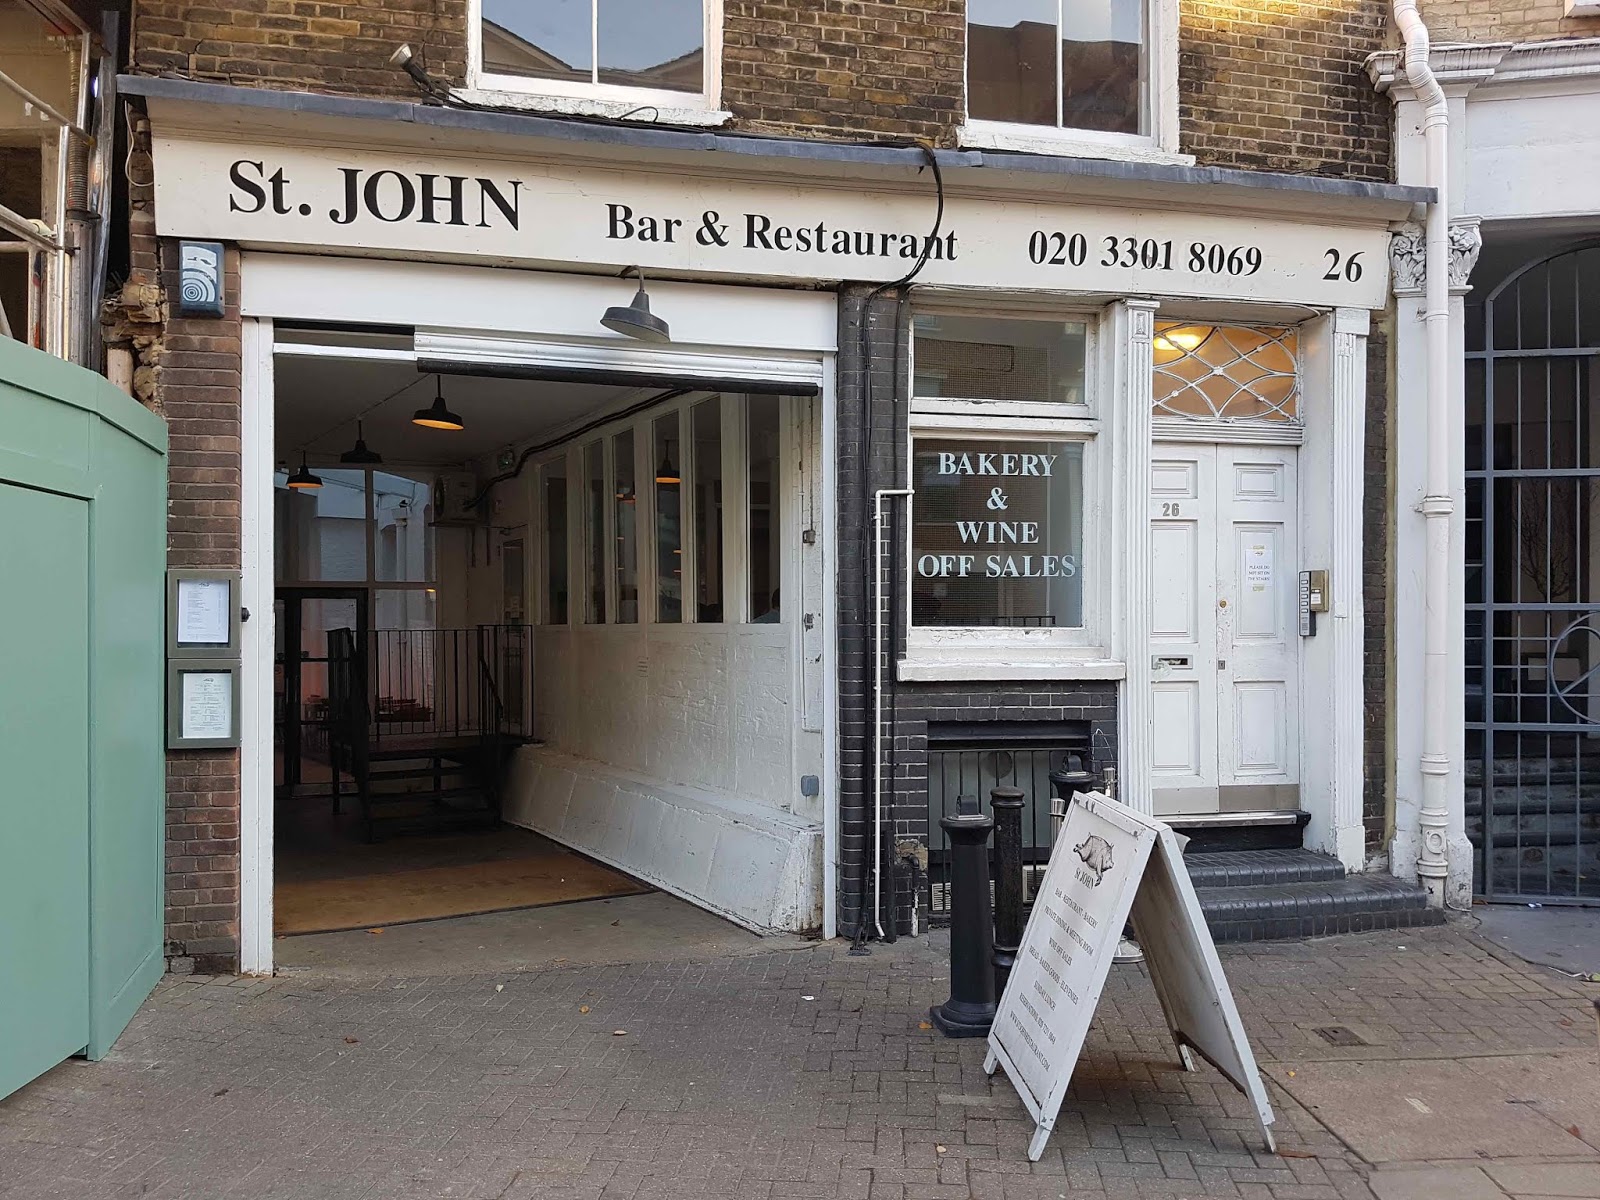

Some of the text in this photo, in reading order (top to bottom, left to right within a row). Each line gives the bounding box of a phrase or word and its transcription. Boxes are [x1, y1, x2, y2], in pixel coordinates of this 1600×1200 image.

[229, 159, 1364, 282] St. JOHN Bar & Restaurant 020 3301 8069 26
[937, 452, 1058, 477] BAKERY
[986, 487, 1009, 510] &
[1162, 503, 1180, 517] 26
[956, 521, 1039, 544] WINE
[917, 554, 1076, 578] OFF SALES
[1079, 871, 1095, 889] JOHN
[1063, 894, 1083, 915] RESTAURANT
[1083, 911, 1099, 928] BAKERY
